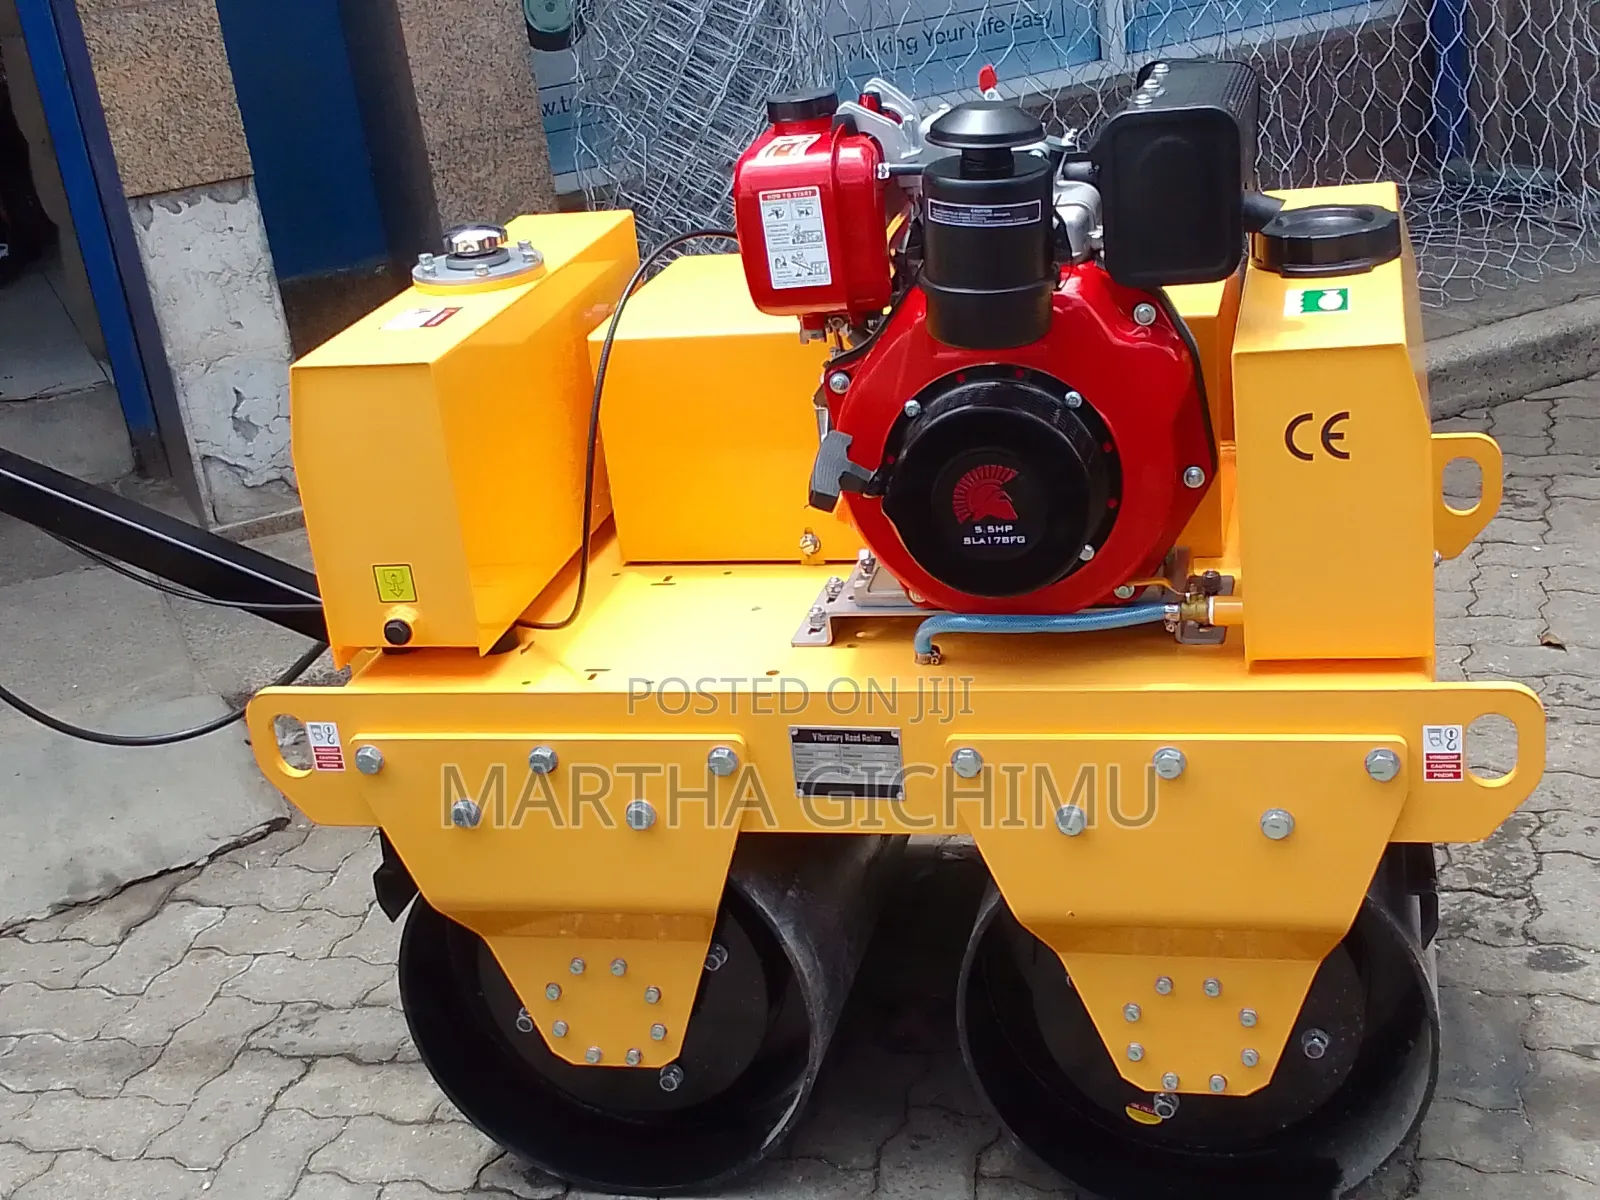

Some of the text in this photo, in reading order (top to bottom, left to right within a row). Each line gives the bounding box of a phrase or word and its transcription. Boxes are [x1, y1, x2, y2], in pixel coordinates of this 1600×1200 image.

[922, 25, 966, 46] Your
[972, 18, 1006, 39] Life
[1010, 11, 1053, 30] Easy
[1285, 411, 1350, 461] CE
[974, 525, 1013, 534] 5.5HP
